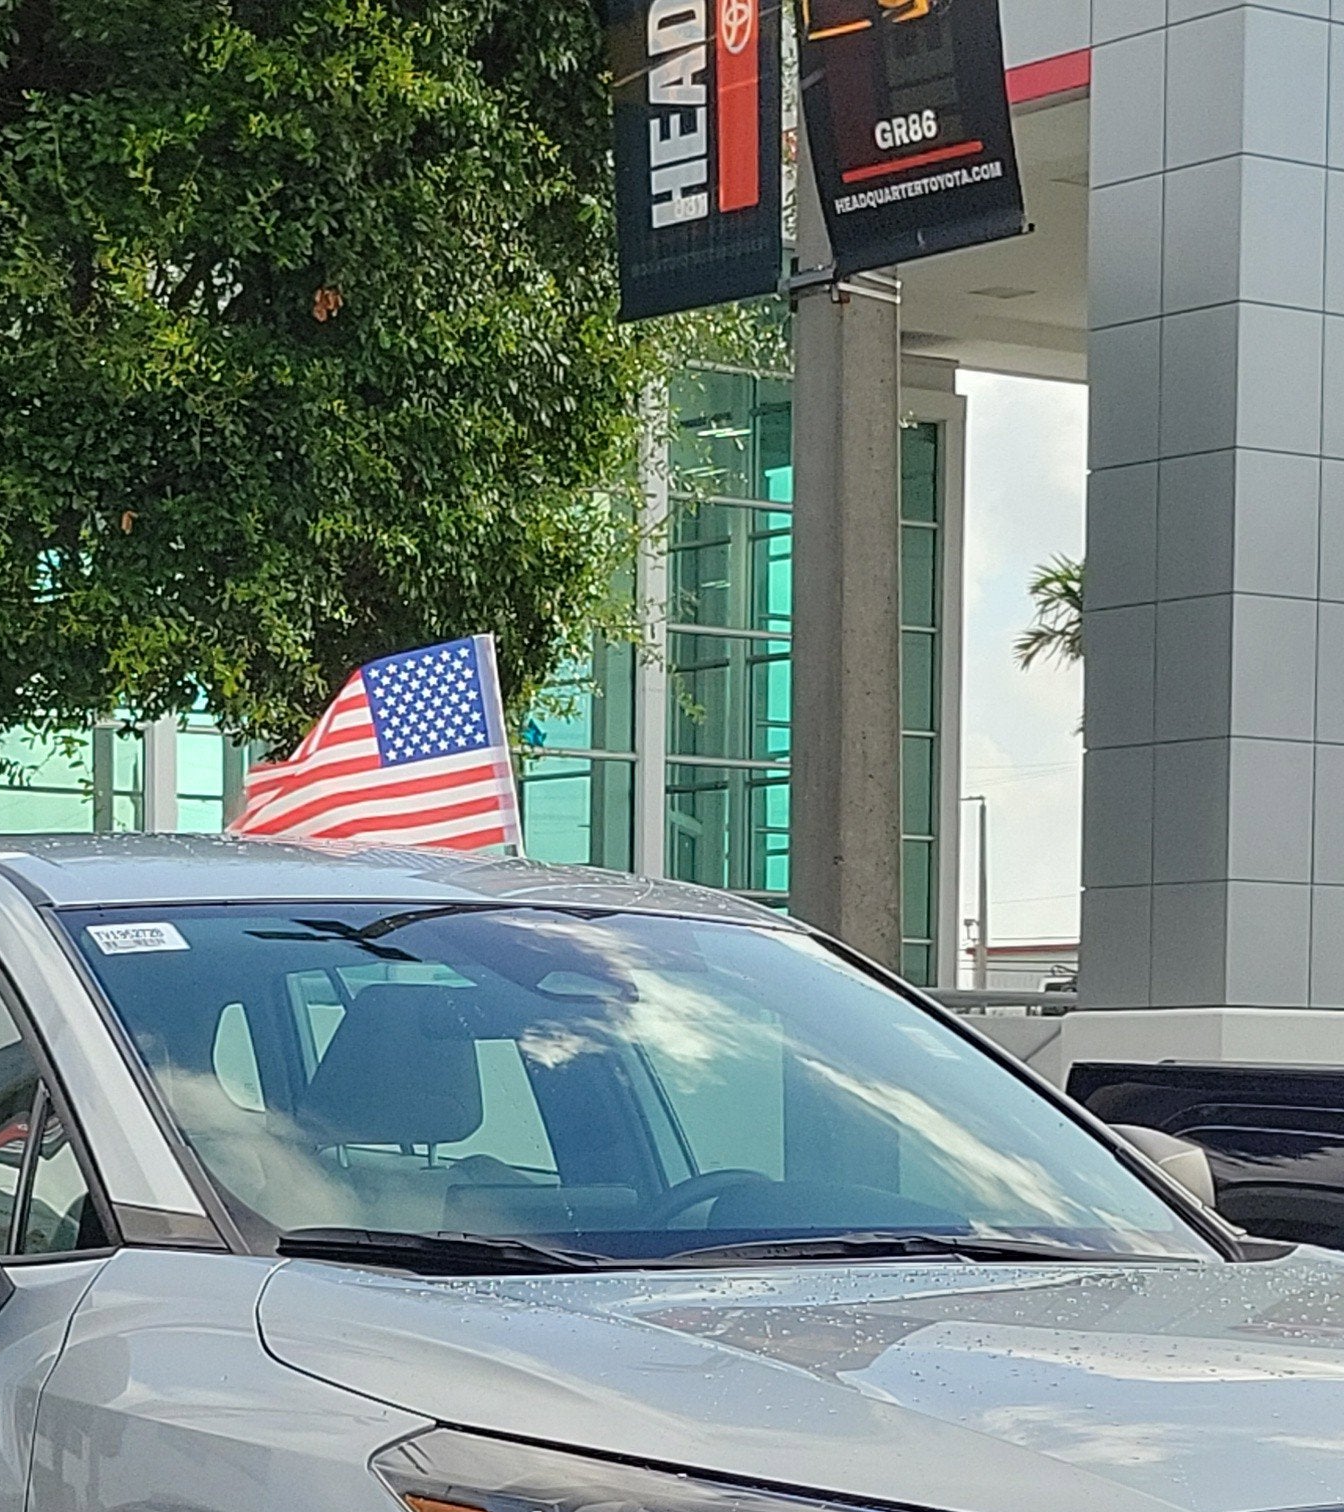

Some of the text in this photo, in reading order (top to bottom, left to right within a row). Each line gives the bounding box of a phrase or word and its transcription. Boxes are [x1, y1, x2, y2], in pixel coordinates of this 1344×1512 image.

[648, 0, 709, 229] HEAD
[874, 109, 938, 151] GR86
[834, 160, 1003, 216] HEADQUARTERTOYOTA.COM
